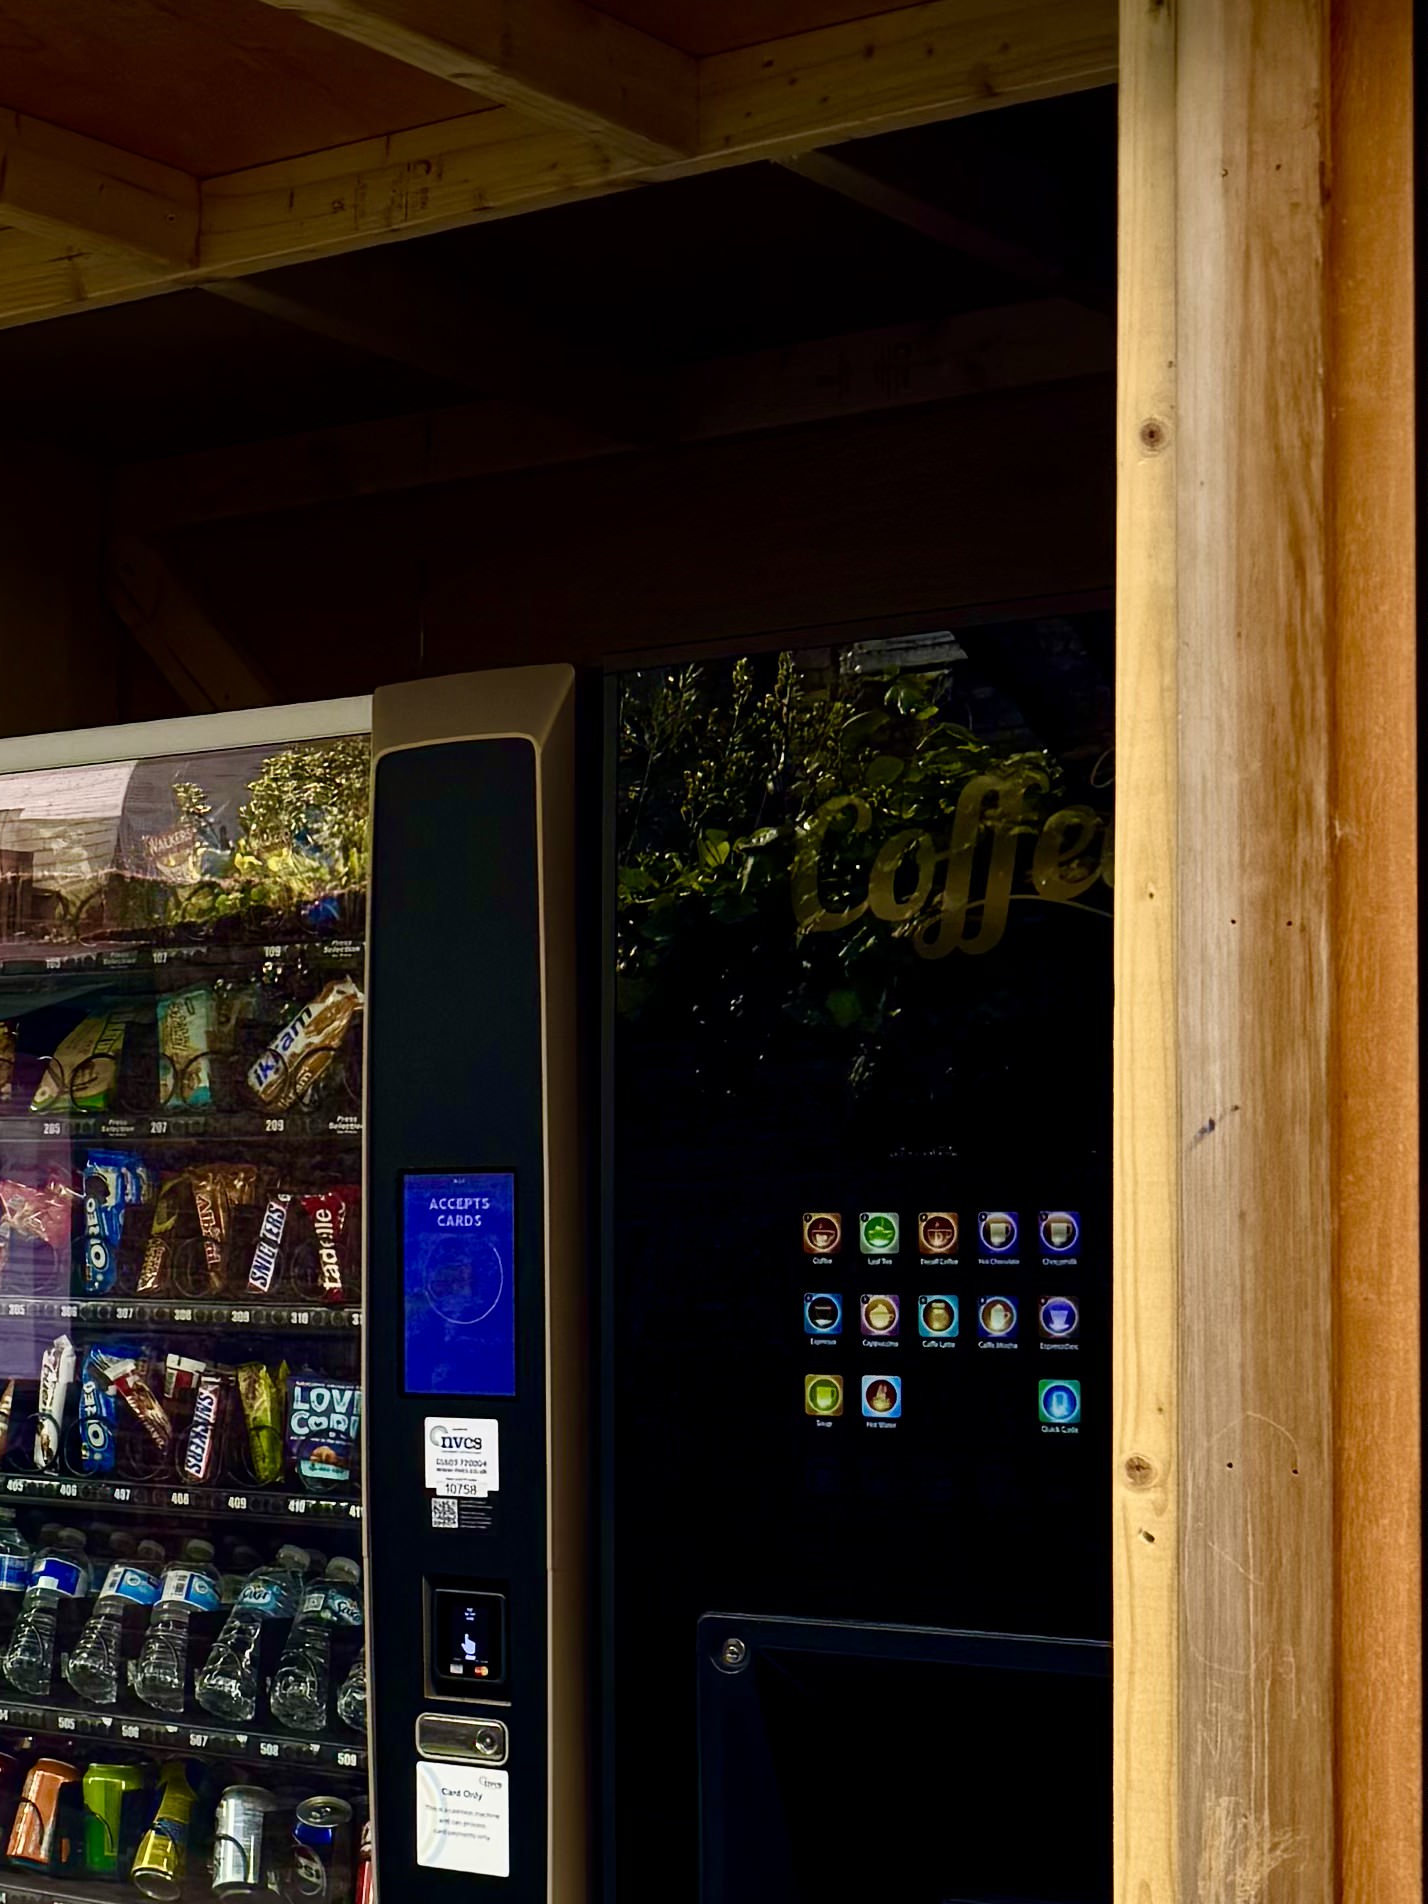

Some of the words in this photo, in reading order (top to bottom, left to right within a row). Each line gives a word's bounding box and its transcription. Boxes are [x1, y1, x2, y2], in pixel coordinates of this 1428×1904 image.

[791, 764, 1114, 959] Coffe
[152, 952, 168, 964] 107
[264, 946, 281, 958] 109
[150, 1121, 168, 1134] 207
[265, 1119, 284, 1132] 209
[429, 1197, 490, 1210] ACCEPTS
[437, 1214, 482, 1227] CARDS
[249, 1202, 286, 1289] SNICERS
[291, 1312, 309, 1324] 310
[352, 1313, 363, 1325] 31
[440, 1436, 483, 1450] nvcs
[59, 1484, 77, 1496] 406
[113, 1488, 131, 1500] 407
[228, 1497, 246, 1509] 409
[288, 1500, 306, 1512] 410
[58, 1717, 76, 1730] 505
[189, 1734, 209, 1747] 507
[260, 1743, 279, 1757] 508
[337, 1752, 357, 1767] 509
[441, 1788, 461, 1797] Card
[463, 1790, 483, 1801] Only
